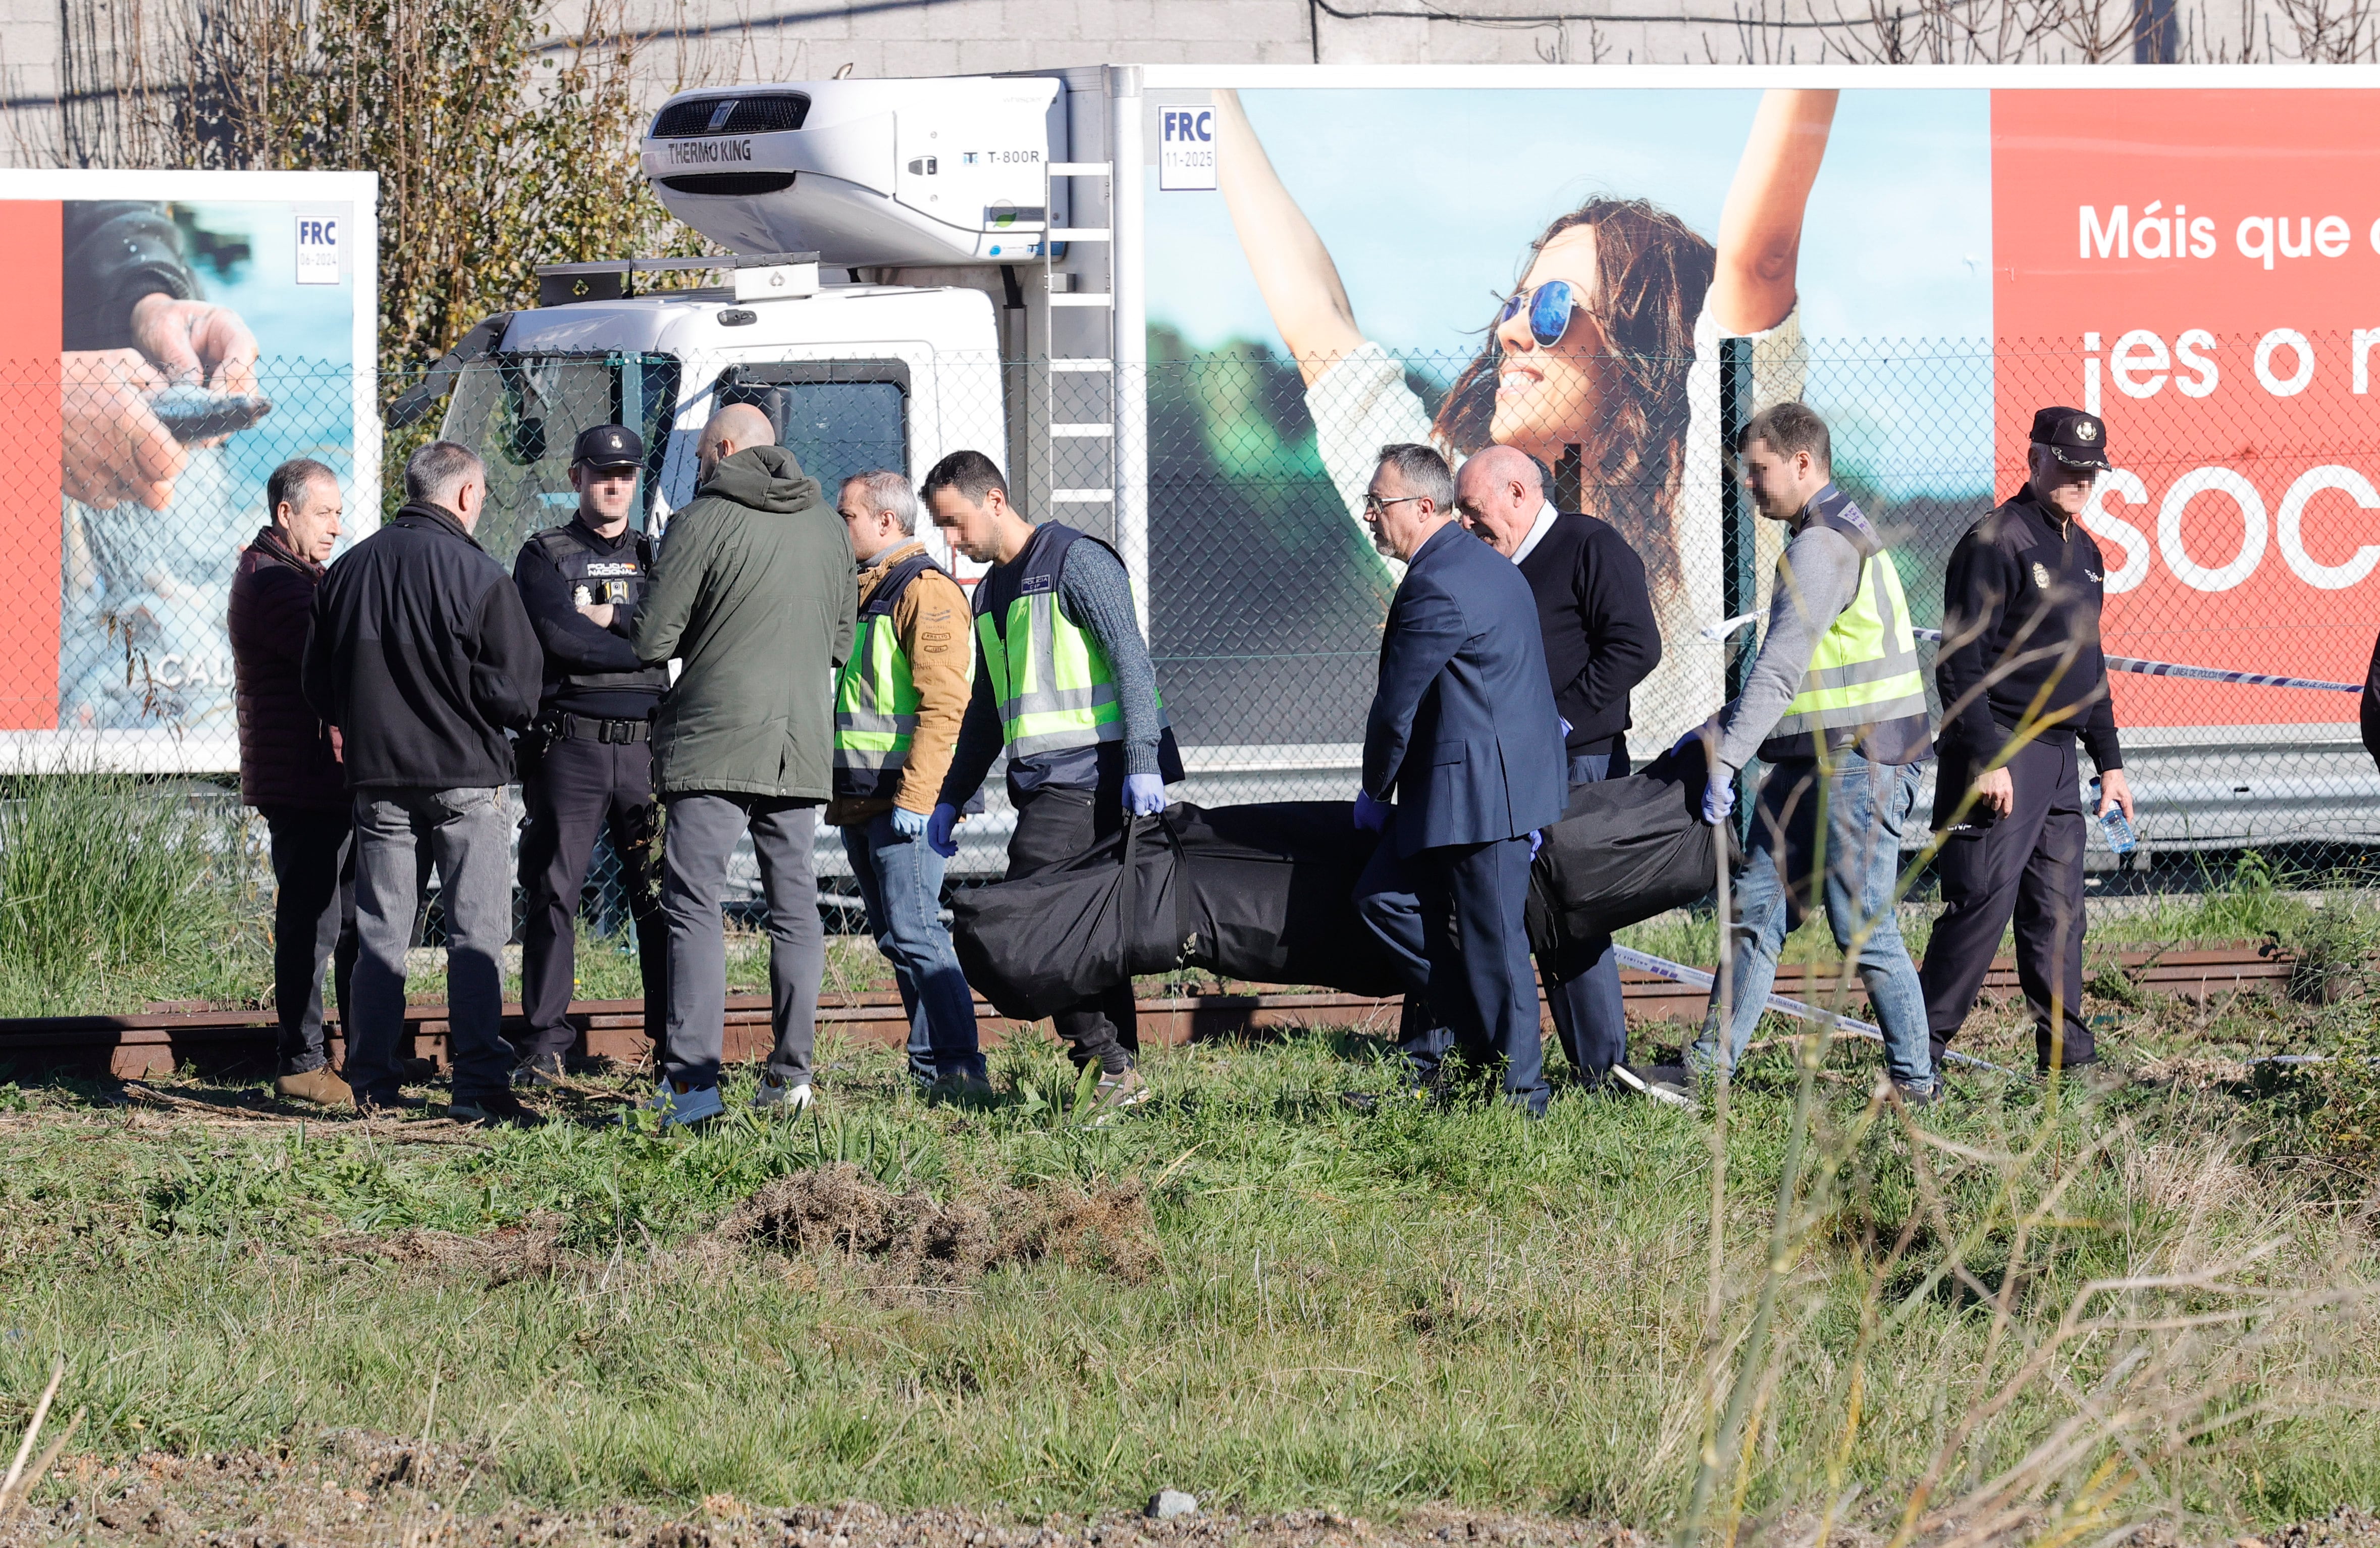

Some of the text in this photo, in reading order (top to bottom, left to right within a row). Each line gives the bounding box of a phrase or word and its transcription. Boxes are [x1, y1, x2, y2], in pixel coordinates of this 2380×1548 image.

[1165, 111, 1211, 142] FRC
[668, 139, 752, 165] THERMO KING
[987, 150, 1040, 163] T-800R
[1166, 151, 1212, 167] 11-2025
[300, 221, 336, 245] FRC
[2079, 199, 2217, 259] Máis
[2236, 215, 2351, 270] que
[2253, 328, 2315, 397] o
[588, 569, 638, 577] NACIONAL
[1023, 577, 1048, 585] POLICIA
[1946, 822, 1972, 831] CNP
